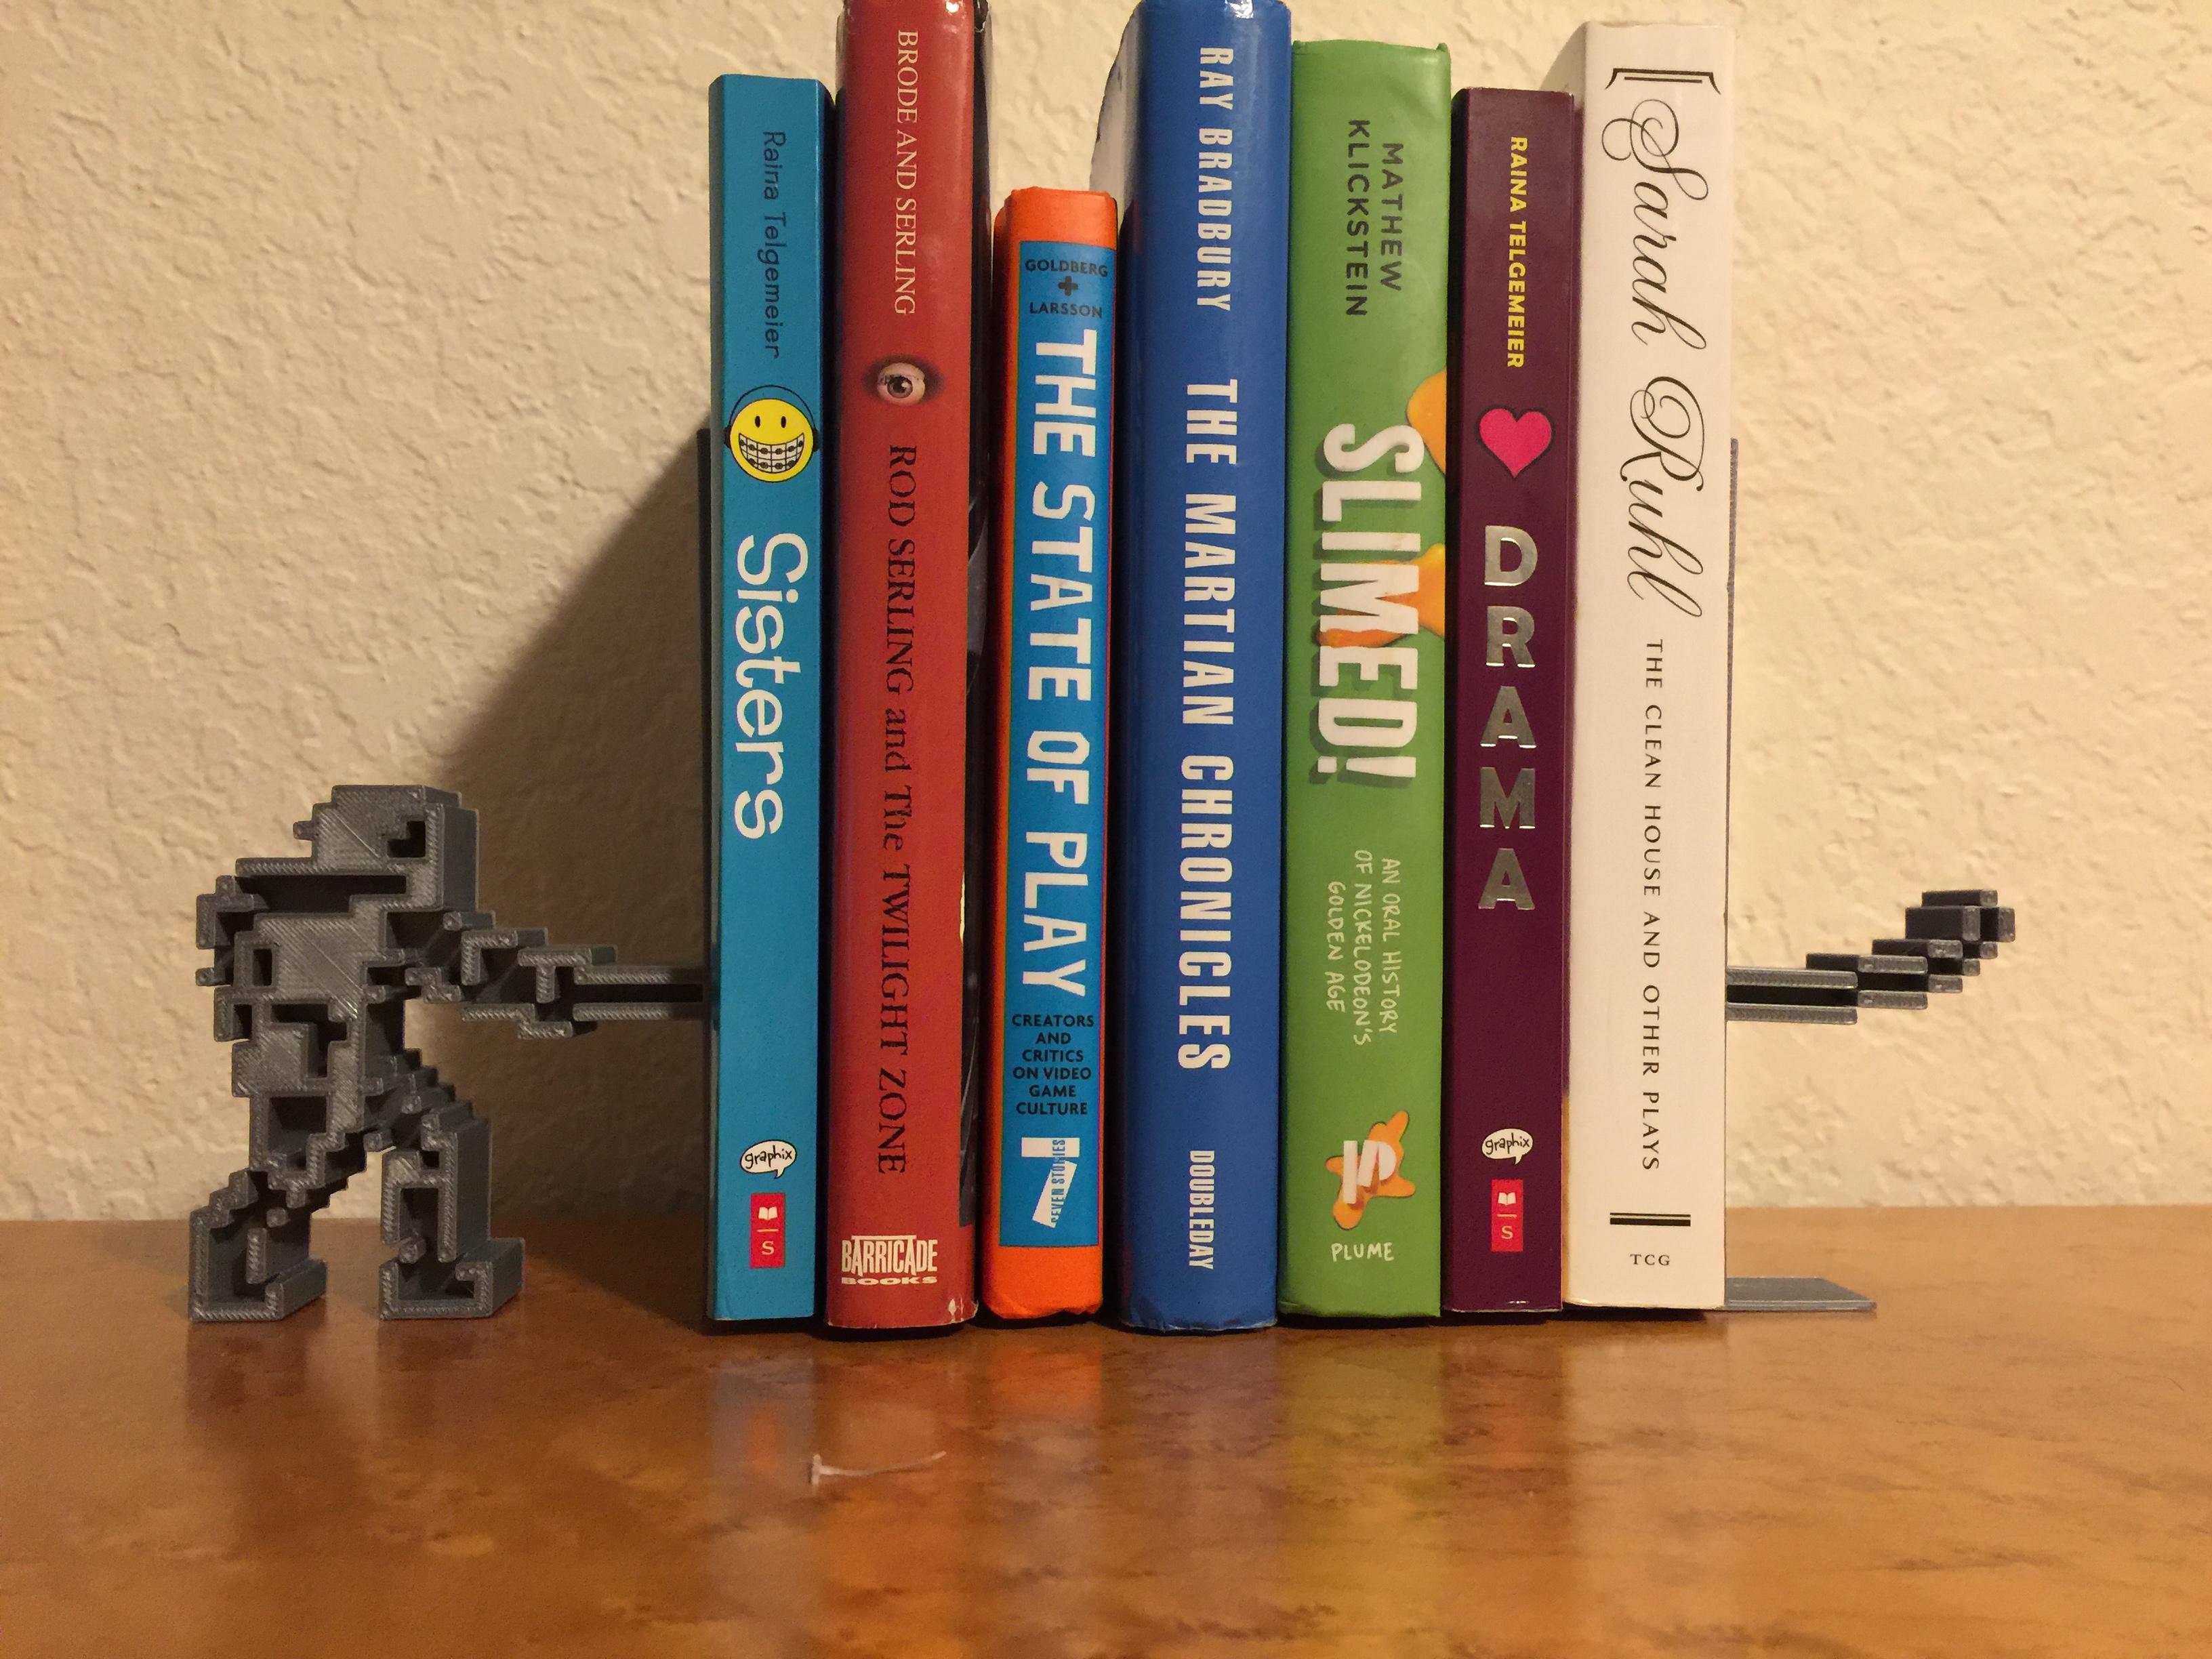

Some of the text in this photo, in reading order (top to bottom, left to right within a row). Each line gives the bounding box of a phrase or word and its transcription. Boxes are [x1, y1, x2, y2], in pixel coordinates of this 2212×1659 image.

[895, 30, 918, 314] BRODE AND SERLING
[1197, 48, 1233, 310] RAY BRADBURY
[1346, 121, 1370, 315] KLICKSTEIN
[1380, 144, 1404, 290] MATHEW
[757, 131, 786, 358] Raina Telgemeier
[1025, 259, 1108, 277] GOLDBERG
[1508, 137, 1528, 367] RAINA TELGEMEIER
[1029, 302, 1103, 319] LARSSON
[1602, 99, 1709, 618] Sarah Ruhl
[1317, 423, 1424, 777] SLIMED!
[735, 533, 808, 838] Sisters
[1023, 329, 1097, 996] THE STATE OF PLAY
[1478, 525, 1538, 909] DRAMA
[1179, 379, 1237, 1068] THE MARTIAN CHRONICLES
[878, 445, 916, 1173] ROD SERLING and The TWILIGHT ZONE
[1325, 881, 1346, 1012] GOLDEN AGE
[1353, 851, 1372, 1045] OF NICKELODEON'S
[1379, 858, 1401, 1033] AN ORAL HISTORY
[1643, 640, 1662, 1169] THE CLEAN HOUSE AND OTHER PLAYS
[1012, 1014, 1094, 1027] CREATORS
[1013, 1067, 1091, 1080] ON VIDEO
[1022, 1050, 1083, 1062] CRITICS
[1036, 1033, 1071, 1044] AND
[1017, 1103, 1087, 1115] CULTURE
[1029, 1085, 1076, 1097] GAME
[1485, 1132, 1530, 1155] graphix
[745, 1145, 792, 1169] graphix
[1021, 1137, 1080, 1228] 7
[1189, 1150, 1214, 1269] DOUBLEDAY
[762, 1241, 775, 1255] S
[841, 1235, 938, 1277] BARRICADE
[841, 1276, 938, 1286] BOOKS
[1332, 1242, 1394, 1261] PLUME
[1501, 1225, 1513, 1240] S
[1630, 1254, 1670, 1266] TCG
